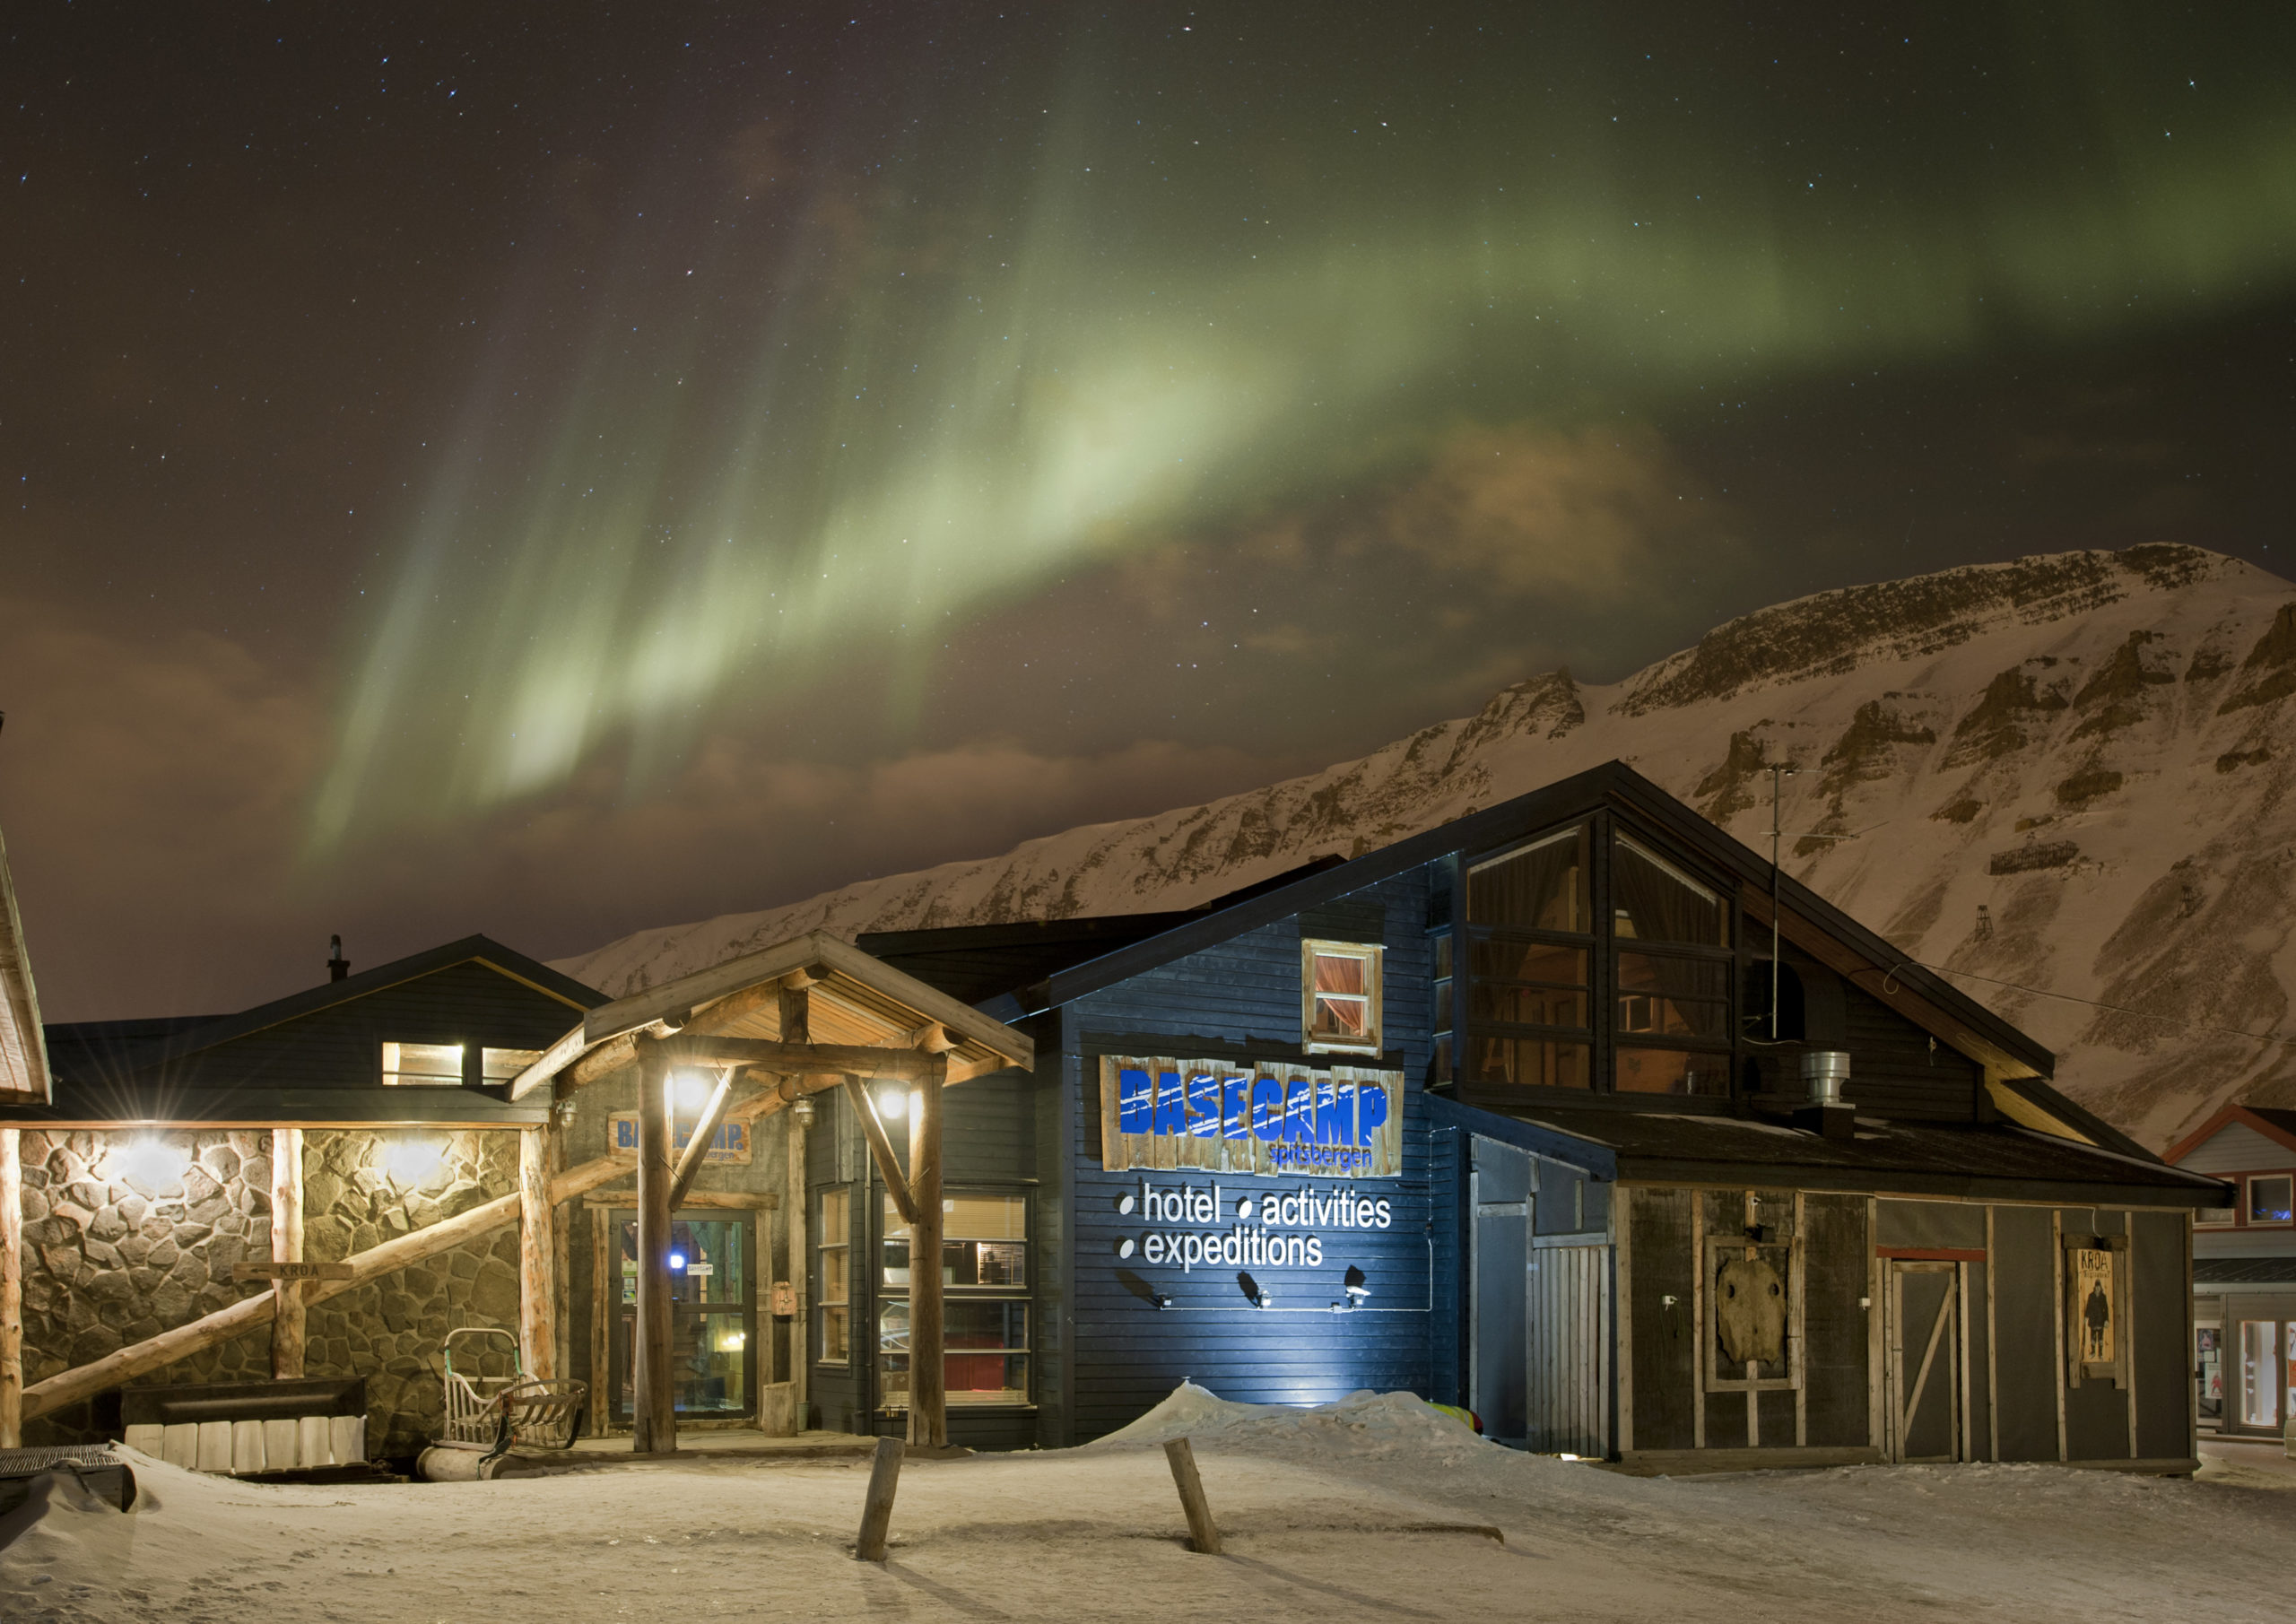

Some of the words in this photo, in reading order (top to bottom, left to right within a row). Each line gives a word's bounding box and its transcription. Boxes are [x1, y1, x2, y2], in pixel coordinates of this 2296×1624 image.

[1120, 1070, 1387, 1146] BASECAMP
[1270, 1144, 1372, 1171] spitsbergen
[1144, 1183, 1221, 1223] hotel
[1262, 1188, 1391, 1228] activities
[1144, 1226, 1323, 1273] expeditions
[2081, 1250, 2109, 1271] KROA
[280, 1264, 319, 1276] KROA
